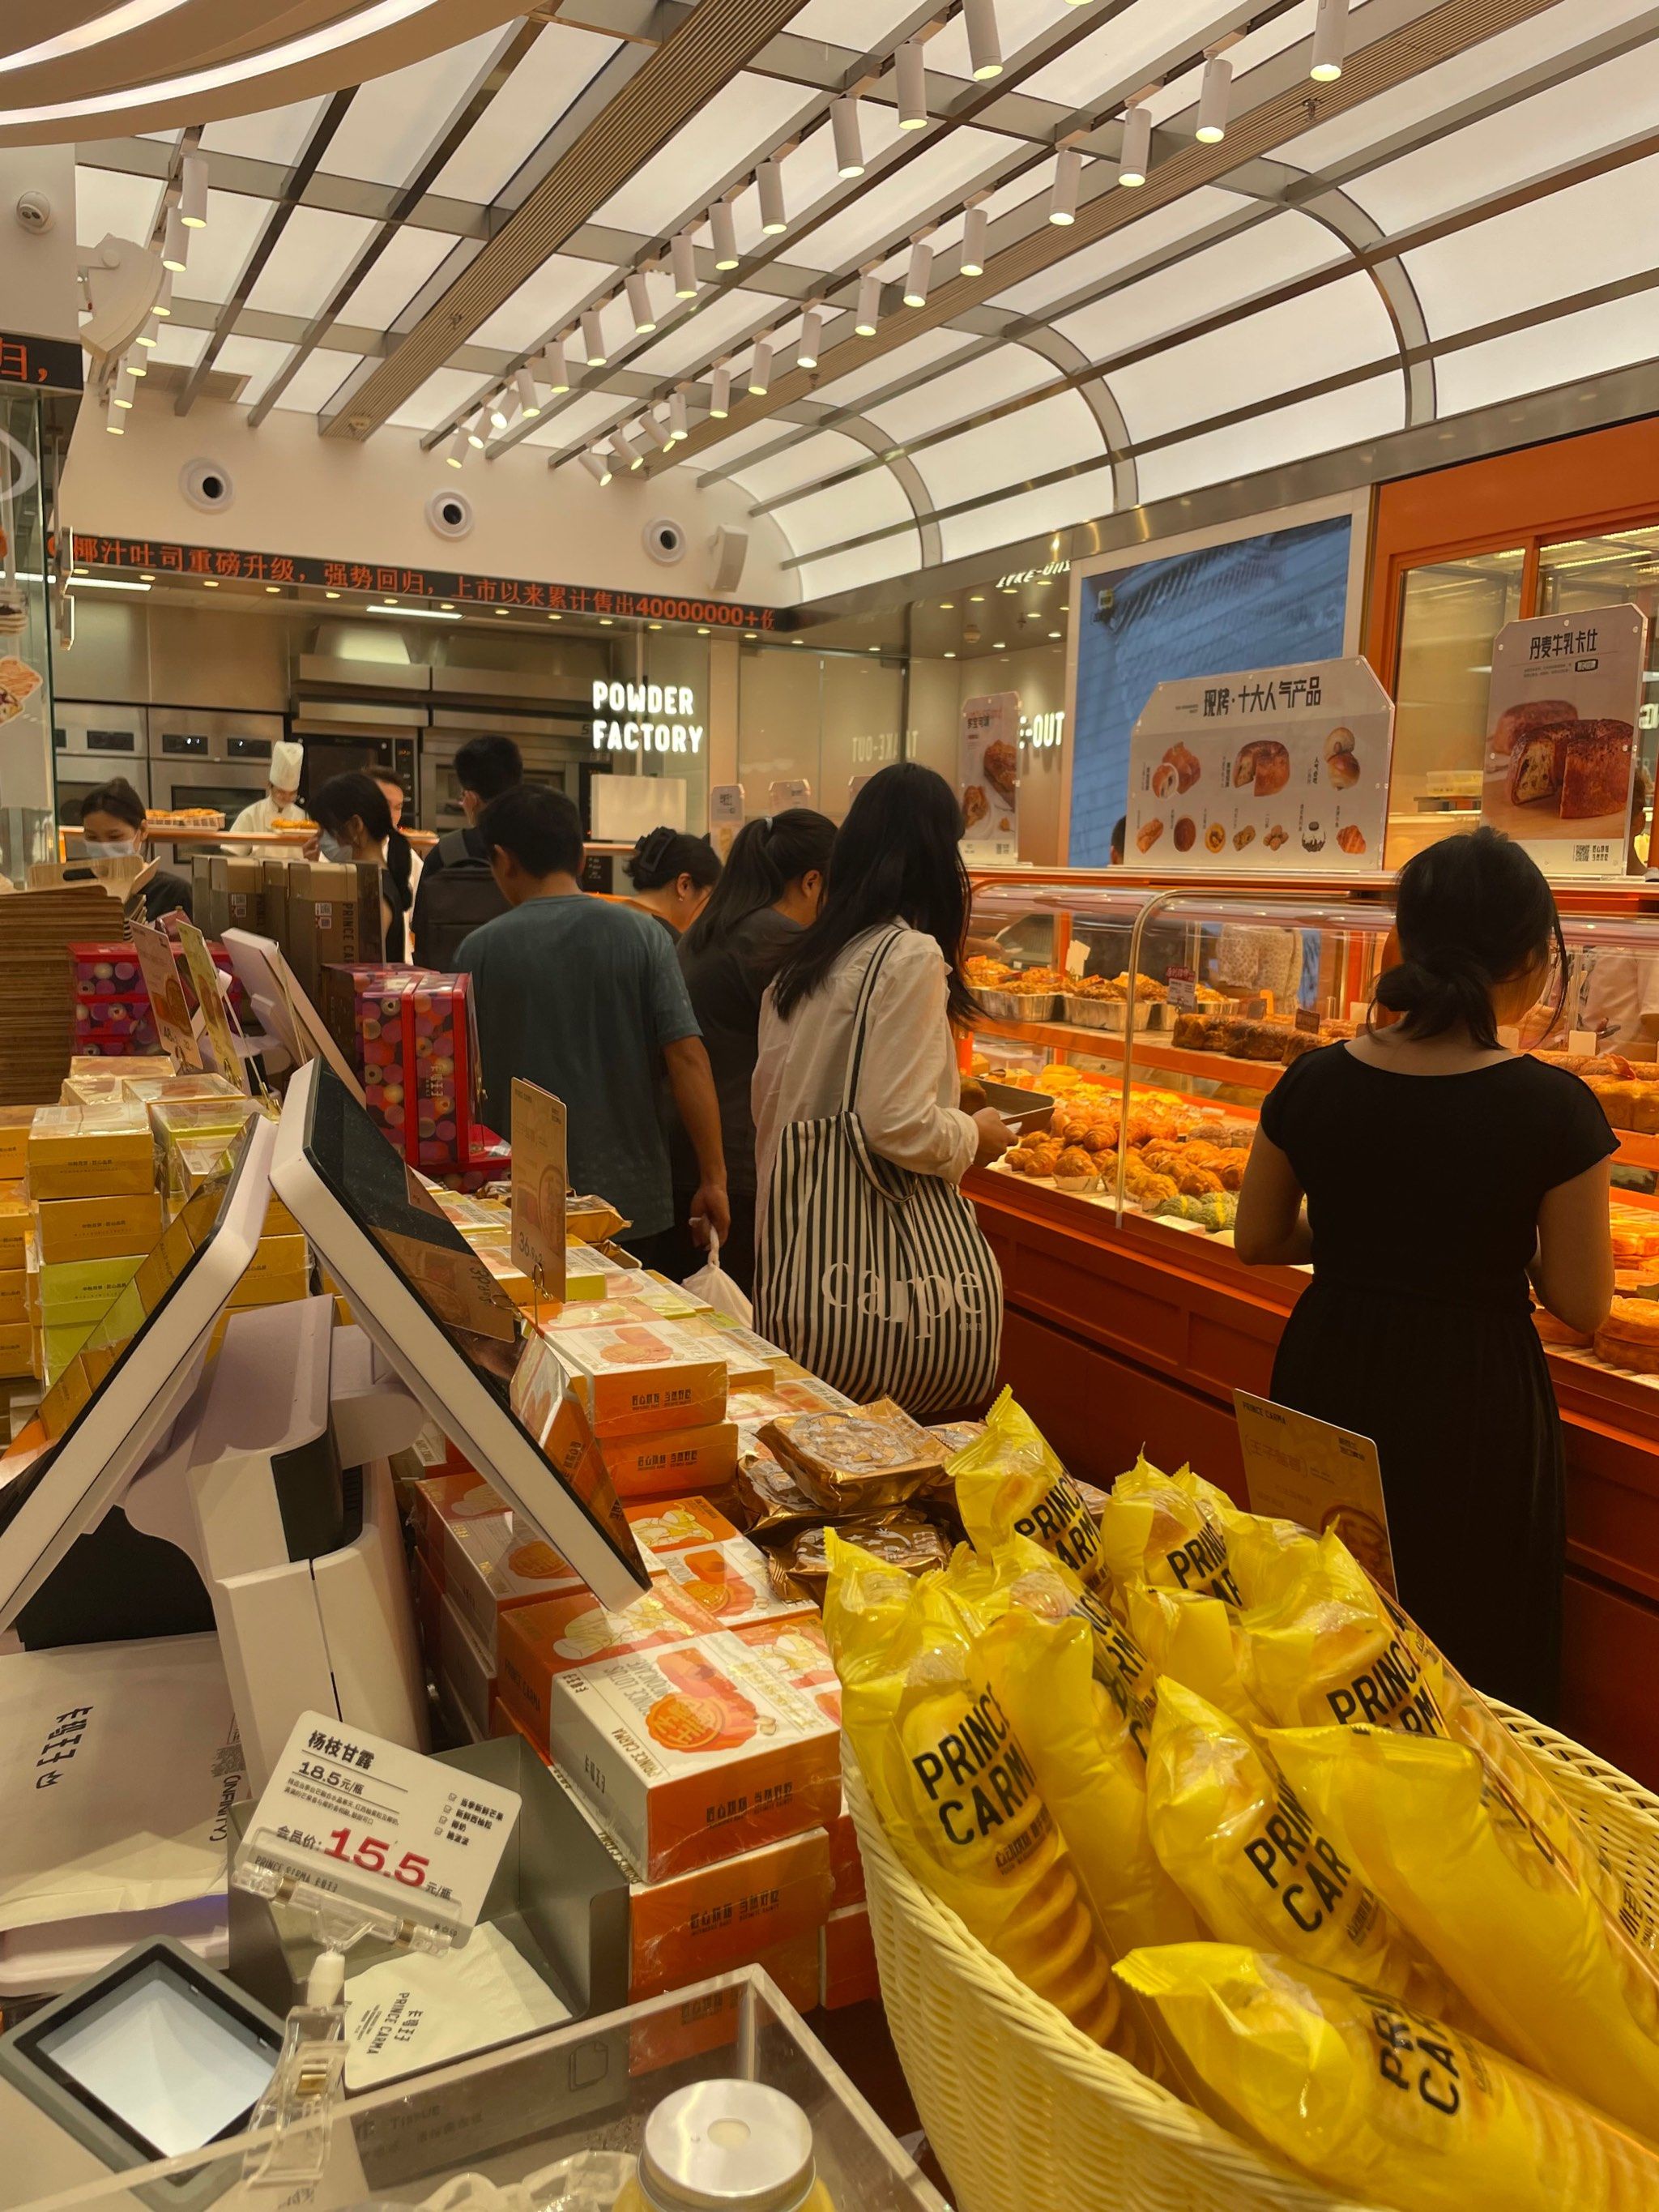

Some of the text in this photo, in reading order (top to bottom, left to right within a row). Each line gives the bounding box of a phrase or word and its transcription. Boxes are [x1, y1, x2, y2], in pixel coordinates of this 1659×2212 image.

[74, 536, 306, 583] 椰汁吐司重磅升级，
[324, 563, 435, 595] 强势回归，
[1529, 629, 1598, 660] 丹麦牛乳卡仕
[591, 680, 694, 715] POWDER
[1203, 676, 1322, 717] 现烤·十大人气产品
[591, 720, 703, 754] FACTORY
[343, 903, 355, 964] PRINCE CAR
[821, 1262, 983, 1339] Carpe
[1013, 1475, 1083, 1539] PRINC
[1055, 1509, 1102, 1571] ARM
[1166, 1521, 1227, 1590] PRIN
[1325, 1640, 1421, 1725] PRINC
[308, 1729, 375, 1770] 杨枝甘露
[912, 1680, 1011, 1801] PRINC
[938, 1732, 1039, 1846] CARM
[1243, 1771, 1314, 1890] PRIN
[1282, 1835, 1352, 1933] CAR
[383, 1992, 410, 2024] PRINCE
[366, 2027, 392, 2054] CARMA
